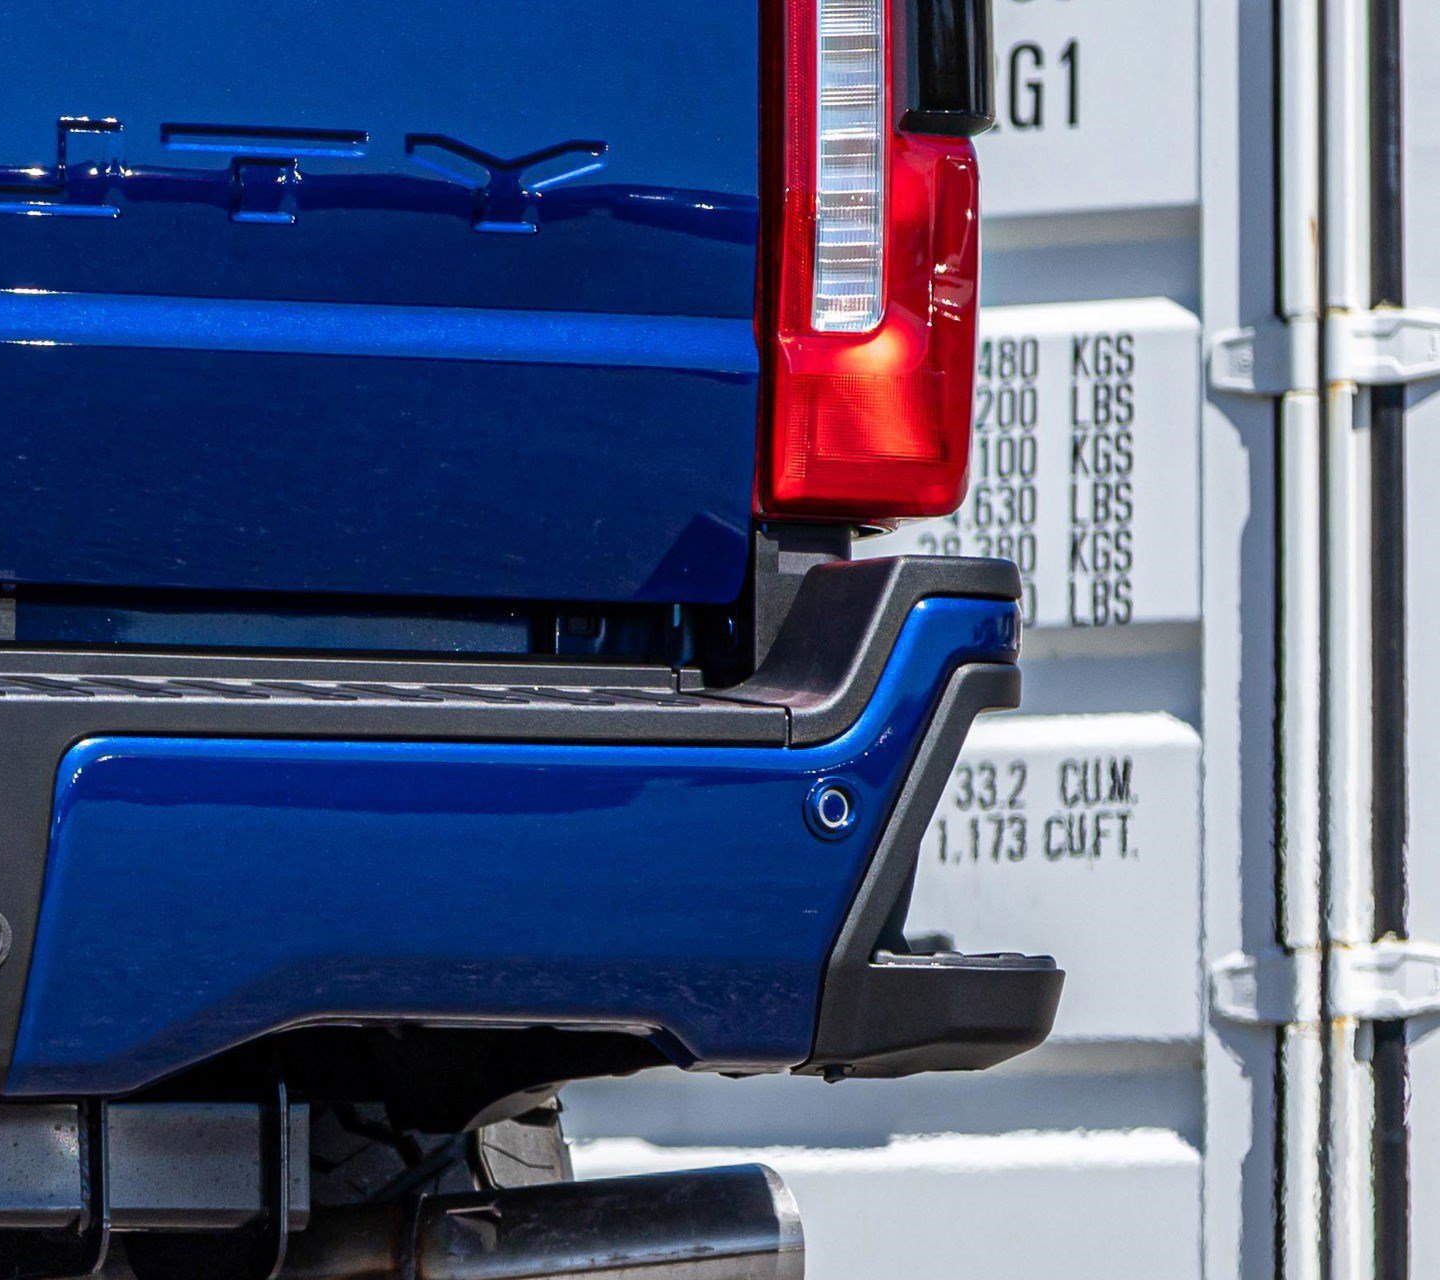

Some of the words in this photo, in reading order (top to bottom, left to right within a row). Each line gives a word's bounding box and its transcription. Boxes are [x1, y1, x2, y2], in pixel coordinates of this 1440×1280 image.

[1071, 333, 1135, 379] KGS
[1071, 382, 1134, 431] LBS
[1071, 431, 1134, 478] KGS
[1070, 479, 1133, 527] LBS
[1069, 529, 1133, 575] KGS
[1069, 578, 1133, 628] LBS
